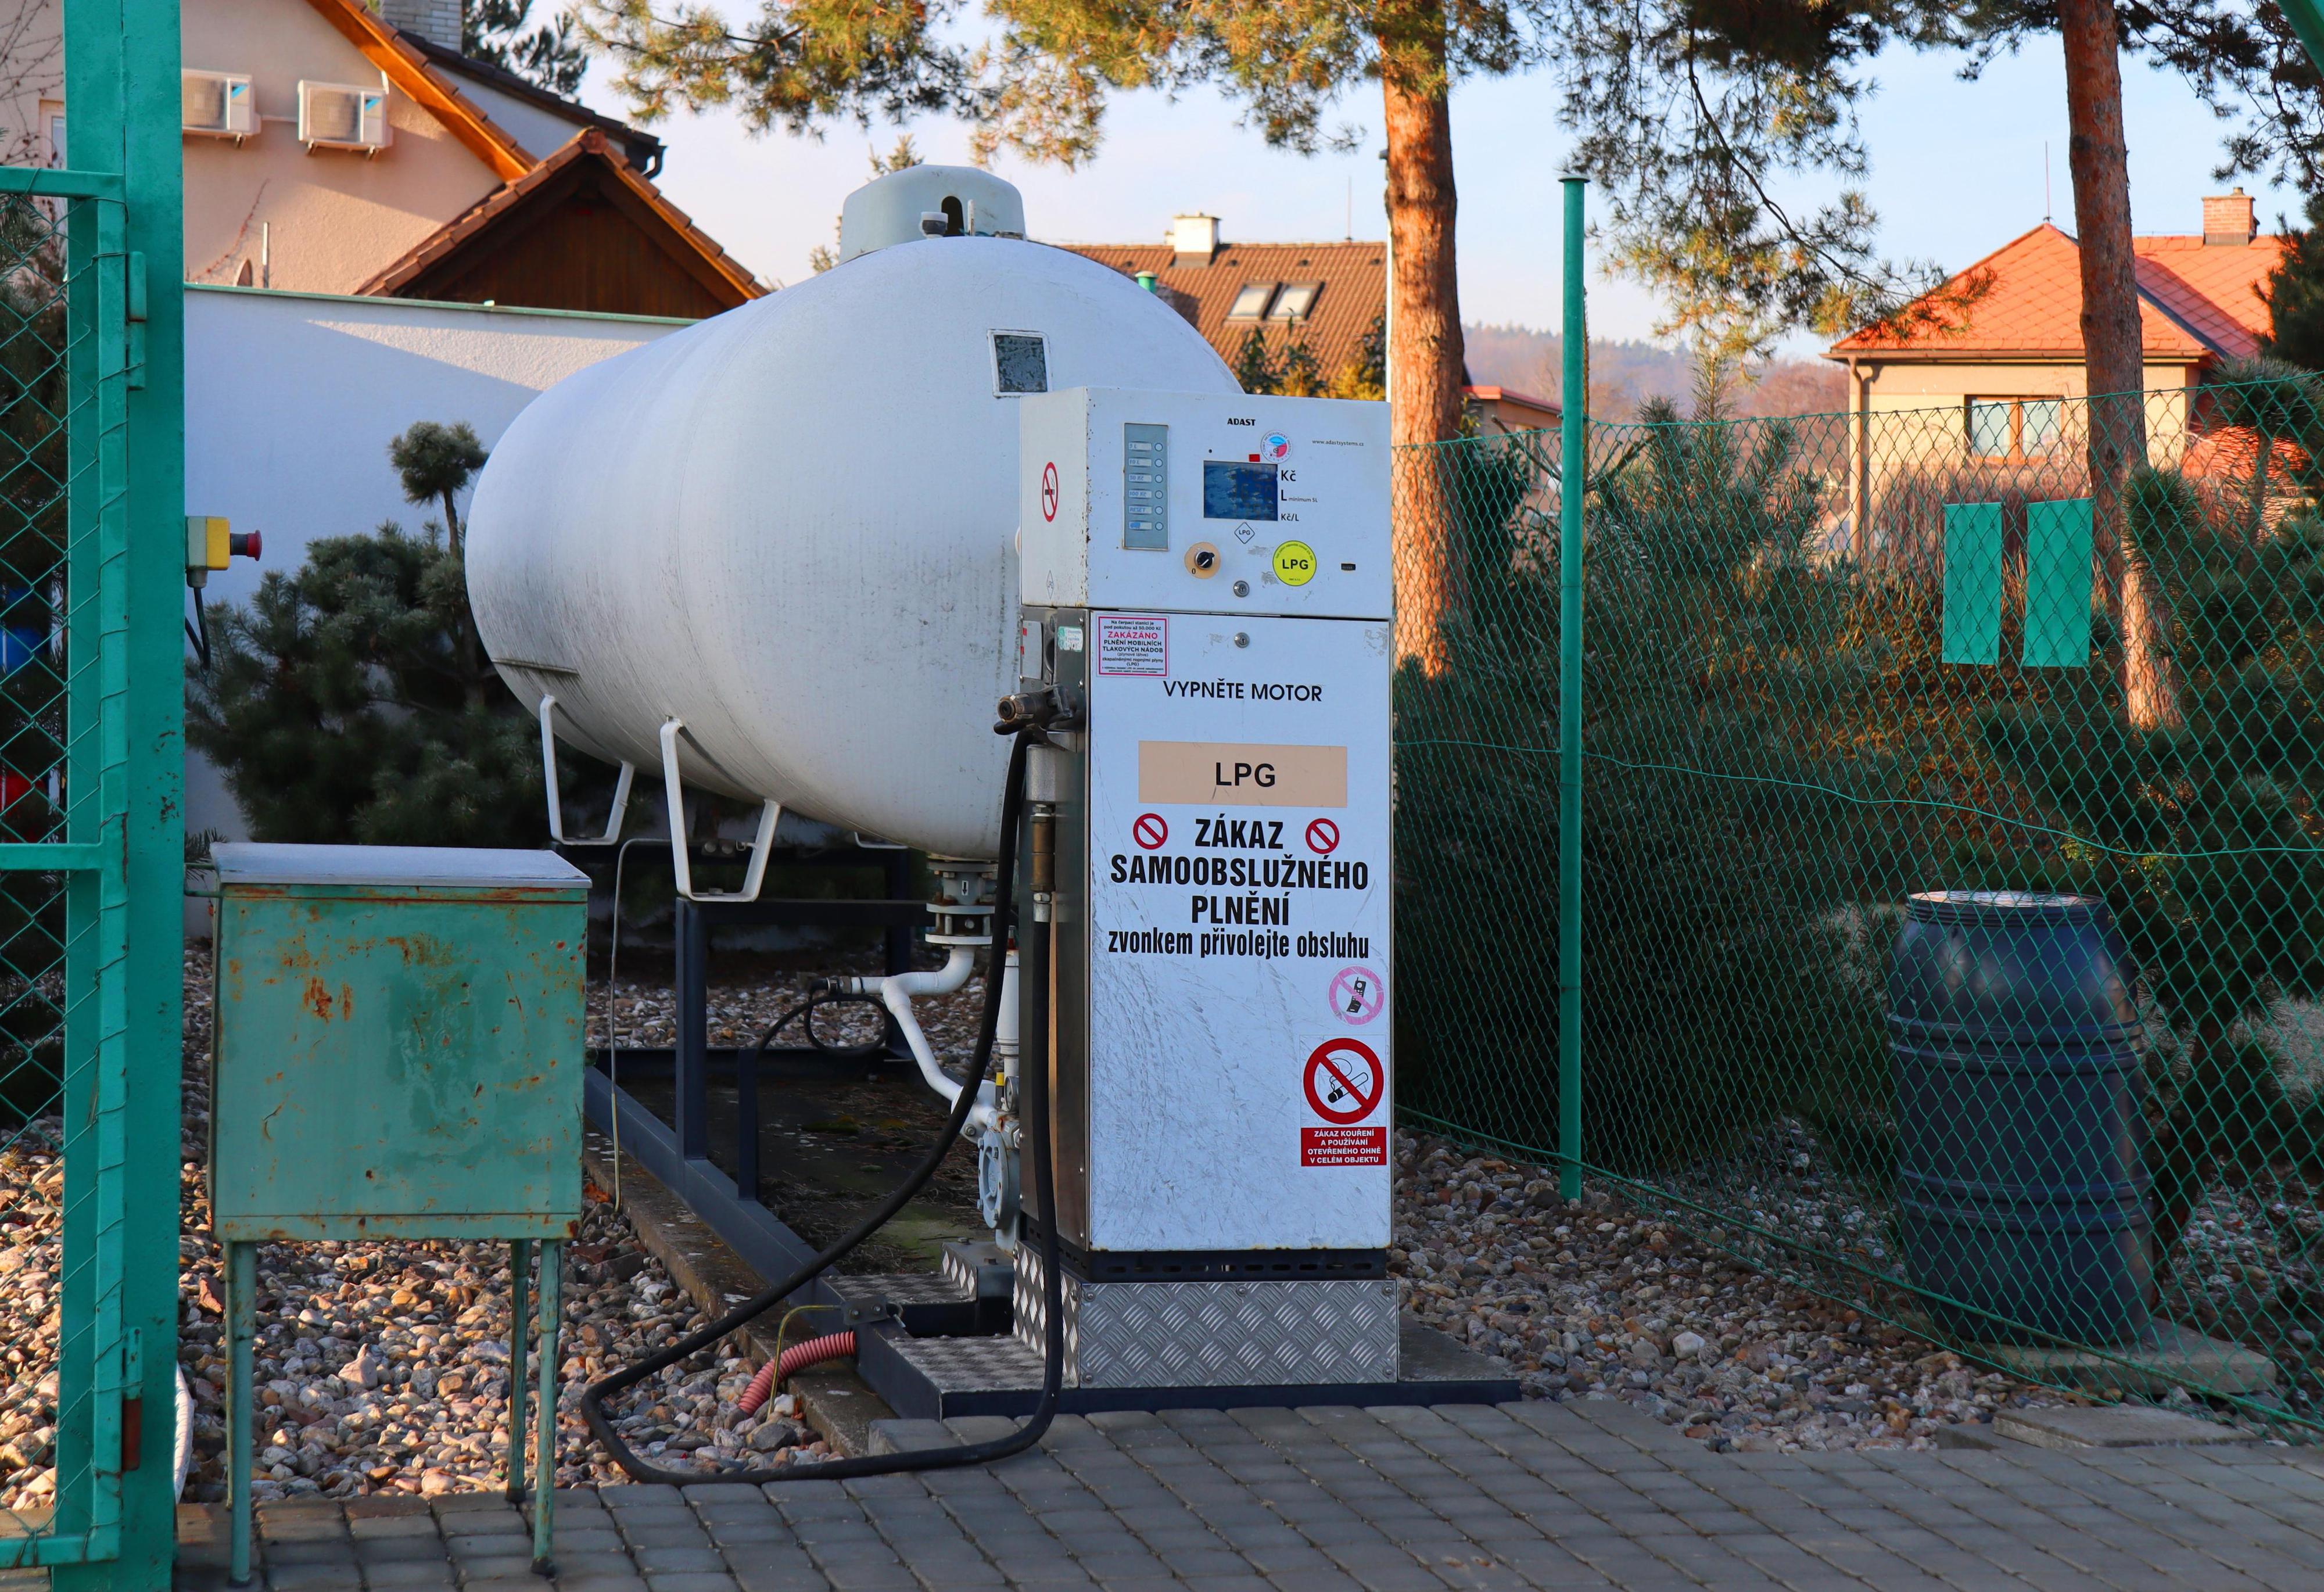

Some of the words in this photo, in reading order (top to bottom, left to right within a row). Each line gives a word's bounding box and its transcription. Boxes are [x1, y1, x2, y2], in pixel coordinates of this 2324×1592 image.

[1227, 418, 1256, 426] ADAST
[1281, 469, 1296, 482] Kč
[1281, 489, 1287, 501] L
[1281, 513, 1299, 521] Kč/L
[1282, 559, 1308, 570] LPG
[1108, 630, 1158, 639] ZAKÁZÁNO
[1163, 679, 1244, 699] VYPNĚTE
[1252, 684, 1321, 701] MOTOR
[1216, 762, 1275, 786] LPG
[1195, 813, 1283, 849] ZÁKAZ
[1111, 854, 1368, 890] SAMOOBSLUŽNÉHO
[1192, 891, 1290, 925] PLNĚNÍ
[1109, 927, 1192, 954] zvonkem
[1201, 928, 1289, 959] přivolejte
[1297, 931, 1368, 958] obsluhu
[1340, 1128, 1374, 1136] KOUŘENÍ
[1307, 1147, 1358, 1155] OTEVŘENÉHO
